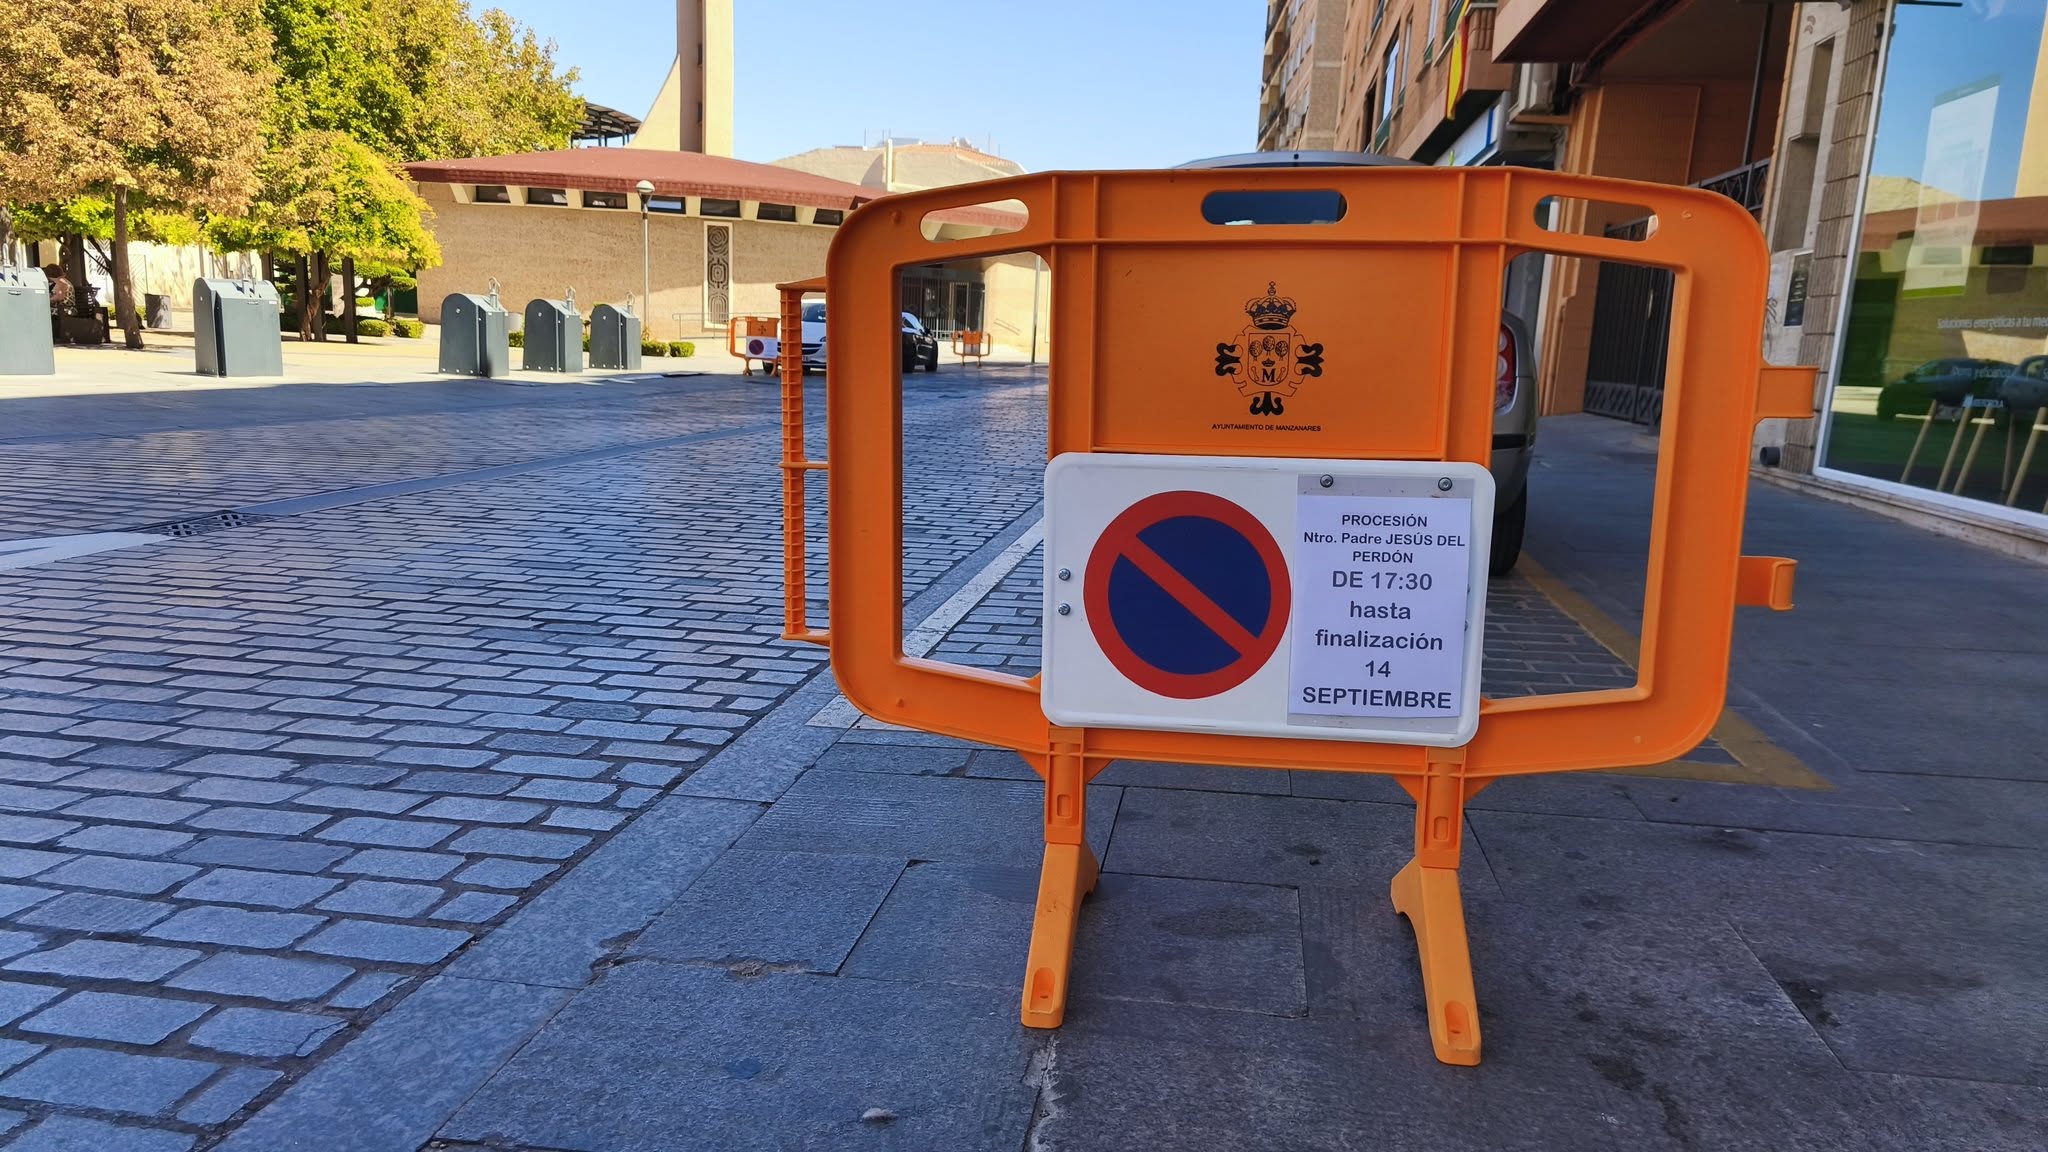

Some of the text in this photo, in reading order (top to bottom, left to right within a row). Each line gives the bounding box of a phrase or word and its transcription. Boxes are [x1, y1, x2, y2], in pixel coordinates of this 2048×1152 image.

[1262, 368, 1276, 382] M
[1341, 513, 1428, 528] PROCESIÓN
[1303, 532, 1466, 547] Ntro. Padre JESÚS DEL
[1352, 549, 1414, 564] PERDÓN
[1332, 570, 1433, 590] DE 17:30
[1350, 601, 1411, 620] hasta
[1315, 629, 1443, 651] finalización
[1365, 660, 1391, 678] 14
[1302, 686, 1452, 709] SEPTIEMBRE
